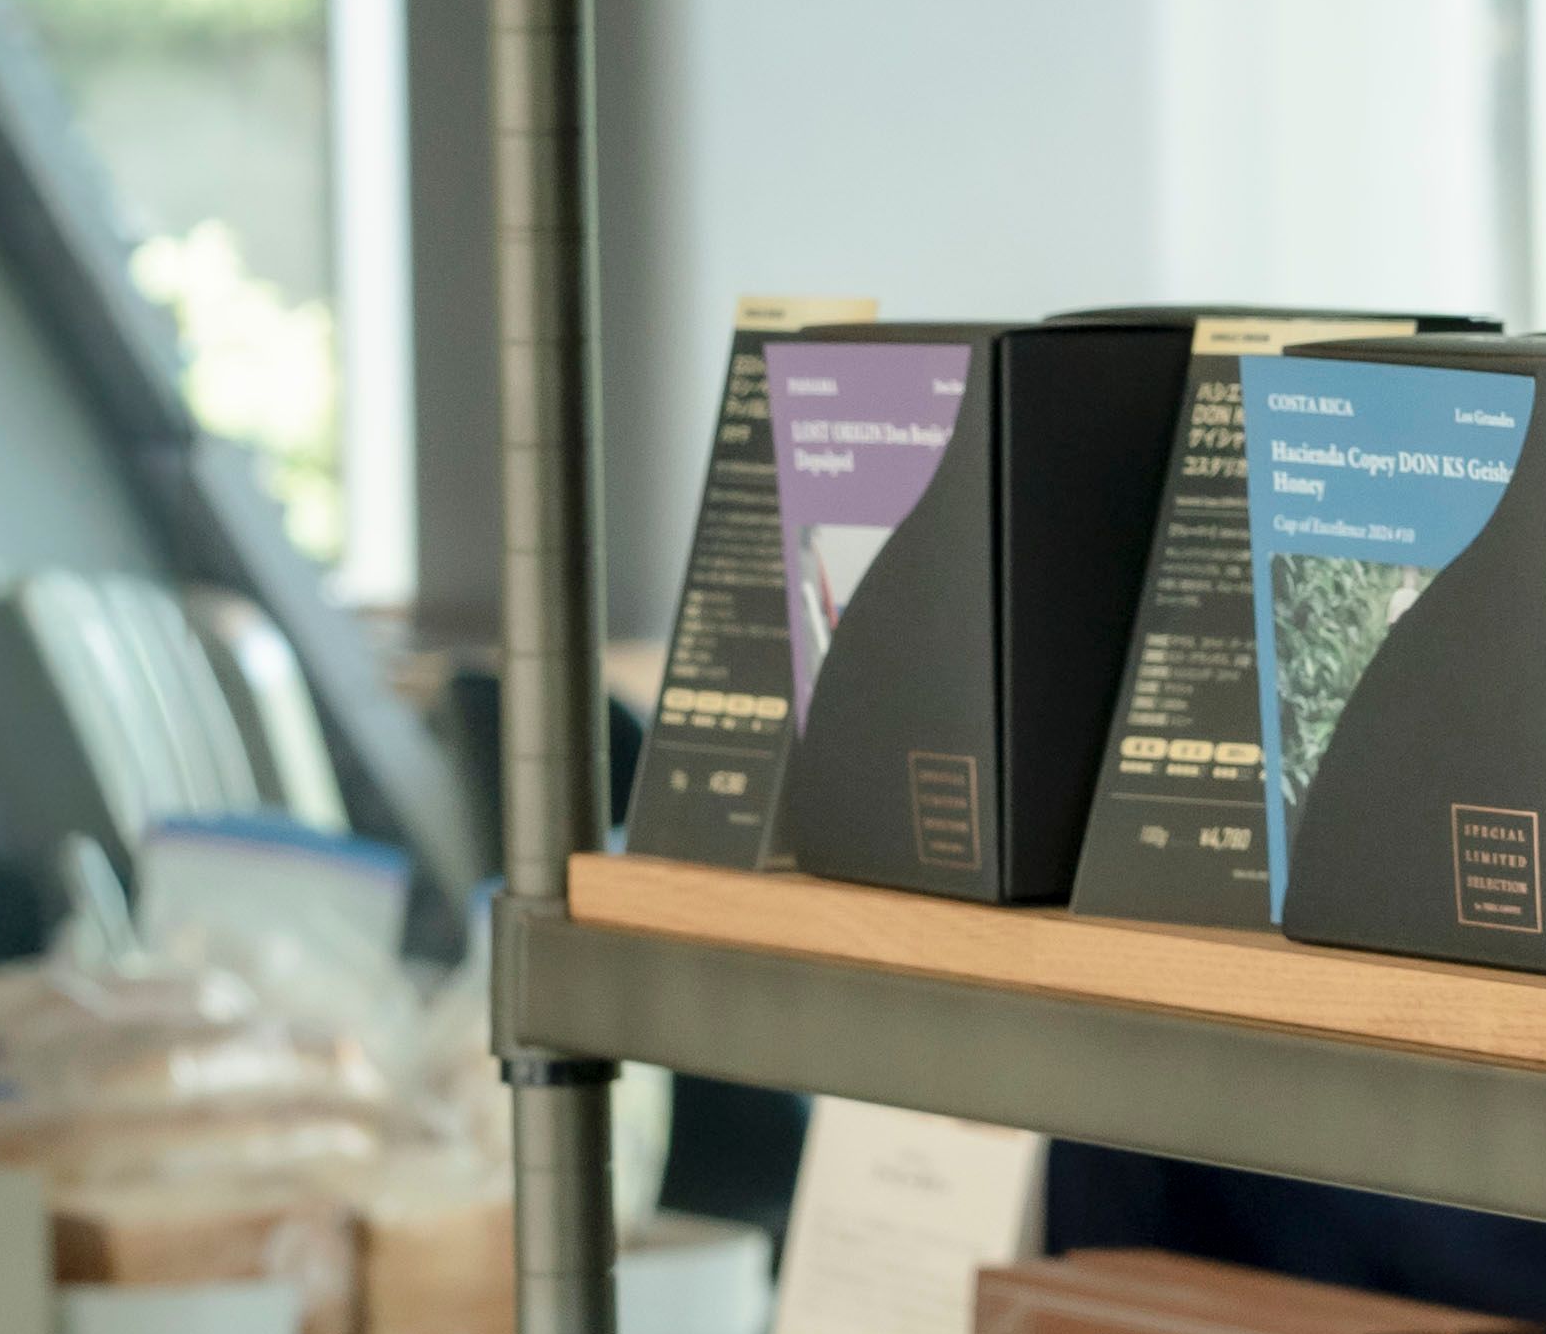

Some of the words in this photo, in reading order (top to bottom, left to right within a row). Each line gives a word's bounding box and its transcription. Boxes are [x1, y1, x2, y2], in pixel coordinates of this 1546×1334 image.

[1267, 393, 1317, 413] COSTA
[1318, 398, 1354, 416] RICA
[1270, 439, 1346, 467] Hacienda
[1347, 446, 1399, 478] Copey
[1398, 450, 1440, 476] DON
[1442, 455, 1466, 479] KS
[1272, 470, 1326, 501] Honey
[1464, 824, 1526, 842] SPECIAL
[1464, 849, 1528, 869] LIMITED
